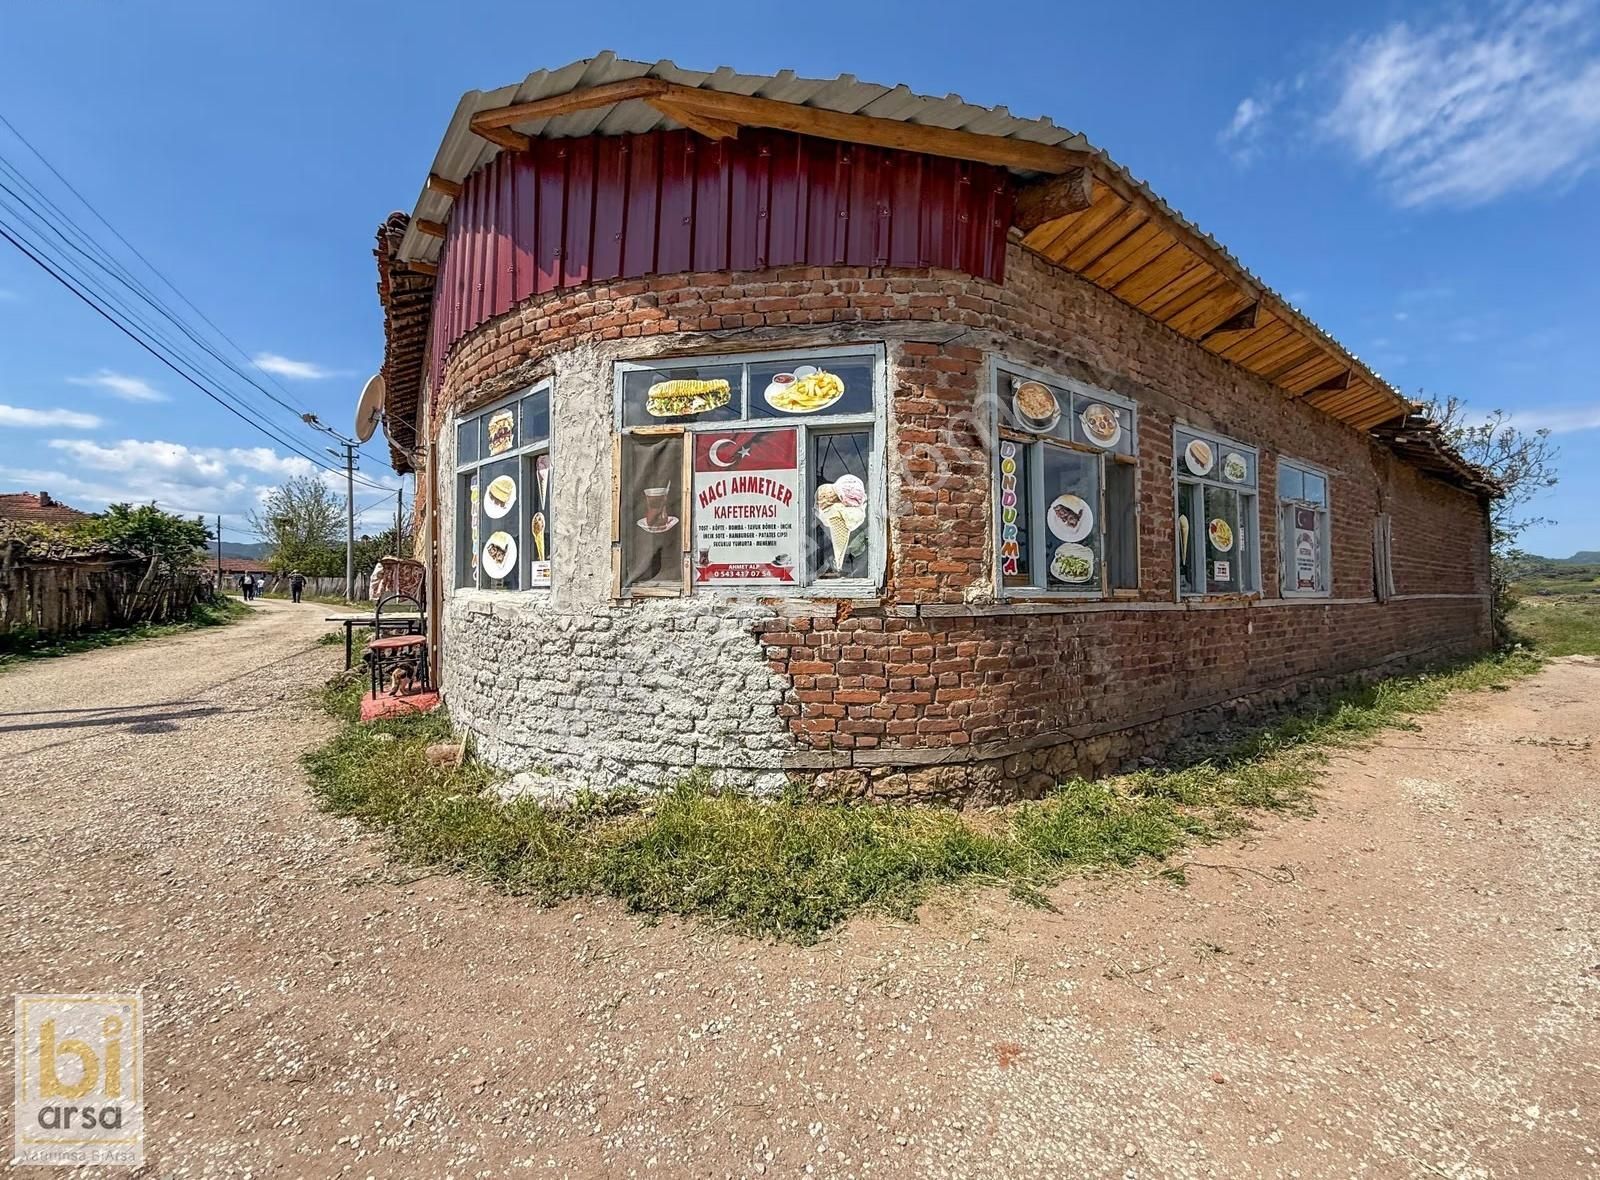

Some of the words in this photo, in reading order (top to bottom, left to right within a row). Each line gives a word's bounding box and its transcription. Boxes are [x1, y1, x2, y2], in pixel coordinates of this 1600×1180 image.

[699, 479, 727, 509] HACI
[731, 476, 792, 507] AHMETLER
[1000, 440, 1019, 575] DONDURMA
[714, 504, 777, 519] KAFETERYASI
